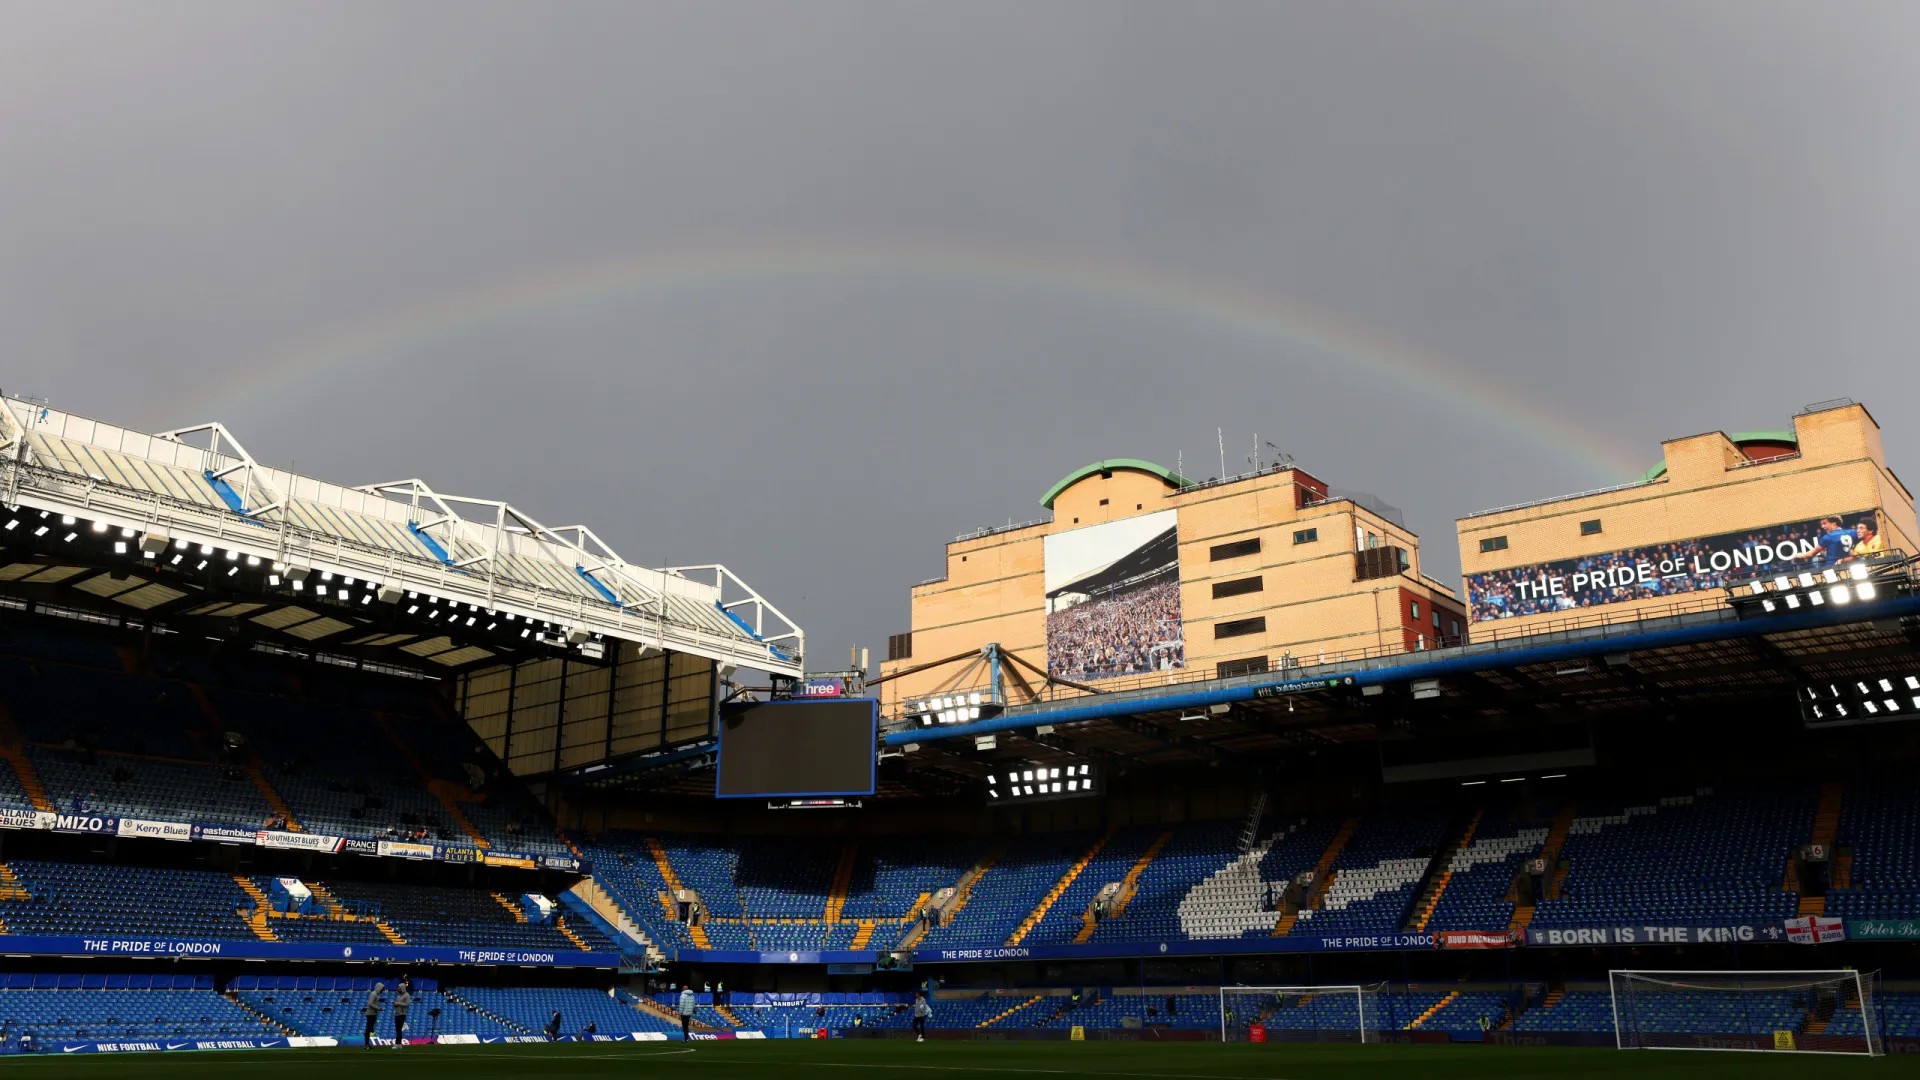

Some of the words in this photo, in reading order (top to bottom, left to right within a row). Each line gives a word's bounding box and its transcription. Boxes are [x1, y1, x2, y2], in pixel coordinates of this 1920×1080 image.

[1840, 534, 1853, 552] 9
[1515, 577, 1563, 600] THE
[1572, 563, 1652, 592] PRIDE
[1659, 558, 1685, 574] OF
[1693, 537, 1820, 574] LONDON
[798, 683, 835, 695] Three
[0, 808, 37, 819] AILAND
[3, 817, 35, 827] BLUES
[56, 814, 103, 831] MIZO
[136, 823, 161, 834] Kerry
[163, 824, 188, 836] Blues
[203, 827, 257, 838] easternblues
[266, 833, 301, 844] SOUTHEAST
[301, 837, 319, 846] BLUES
[346, 839, 376, 849] FRANCE
[445, 853, 474, 861] BLUES
[446, 847, 474, 855] ATLANTA
[1860, 920, 1895, 936] Peter
[1897, 921, 1920, 936] Bo
[1549, 929, 1607, 944] BORN
[1615, 927, 1635, 943] IS
[1643, 926, 1688, 943] THE
[1697, 925, 1754, 942] KING
[84, 940, 108, 951] THE
[112, 940, 150, 952] PRIDE
[154, 941, 166, 949] OF
[168, 942, 221, 953] LONDON
[1322, 938, 1342, 947] THE
[1345, 936, 1378, 947] PRIDE
[1380, 936, 1392, 944] OF
[1394, 935, 1434, 946] LONDO
[459, 950, 476, 960] THE
[478, 951, 505, 961] PRIDE
[517, 953, 554, 963] LONDON
[942, 950, 956, 959] THE
[958, 949, 982, 959] PRIDE
[994, 948, 1029, 958] LONDON
[504, 1035, 519, 1043] NIKE
[519, 1035, 549, 1043] FOOTBALL
[688, 1032, 718, 1041] Three
[1490, 1032, 1547, 1046] Three
[96, 1043, 119, 1052] NIKE
[119, 1042, 161, 1052] FOOTBALL
[196, 1041, 217, 1050] NIKE
[217, 1040, 255, 1049] FOOTBALL
